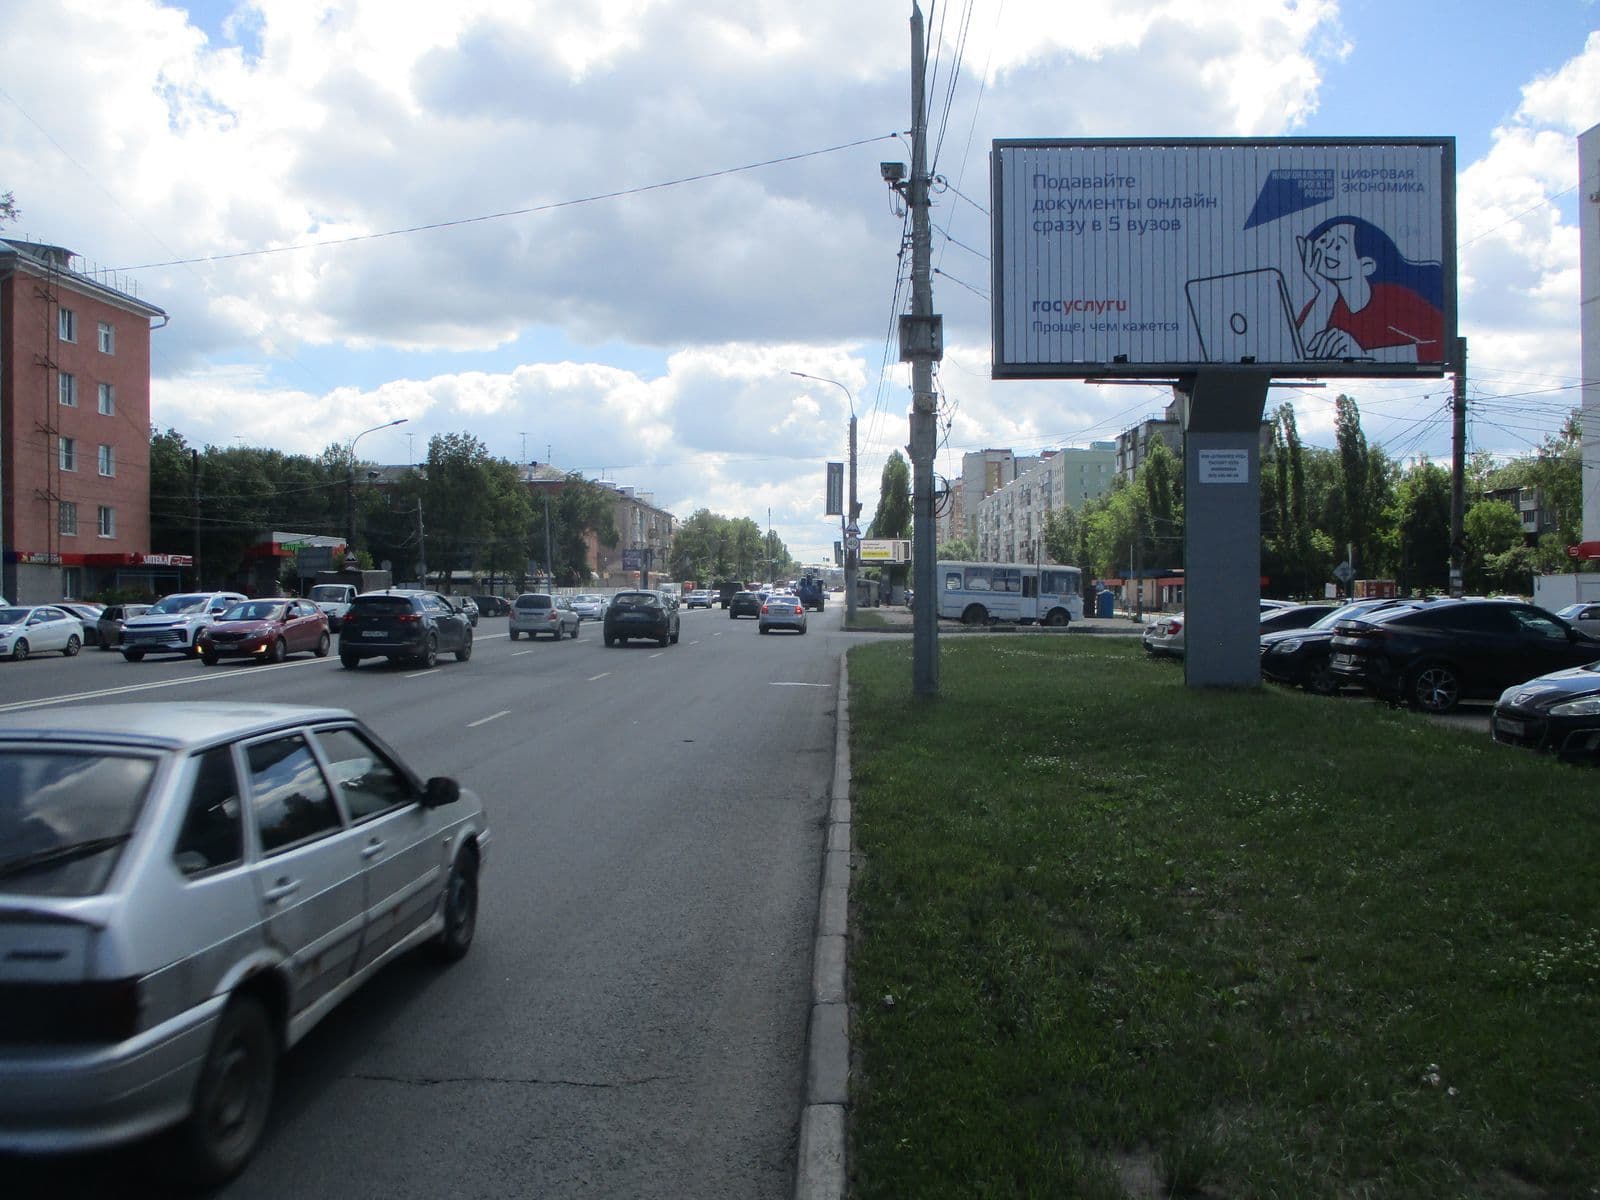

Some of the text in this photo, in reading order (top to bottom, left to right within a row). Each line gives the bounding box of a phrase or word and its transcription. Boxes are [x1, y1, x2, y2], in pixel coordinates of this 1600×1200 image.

[1341, 168, 1414, 180] ЦИФРОВАЯ
[1032, 173, 1136, 191] Подавайте
[1341, 182, 1424, 193] ЭКОНОМИКА
[1032, 193, 1217, 214] документы онлайн
[1032, 216, 1182, 235] сразу в 5 вузов
[1032, 300, 1127, 315] госуслуги
[1032, 321, 1180, 335] Проще, чем кажется
